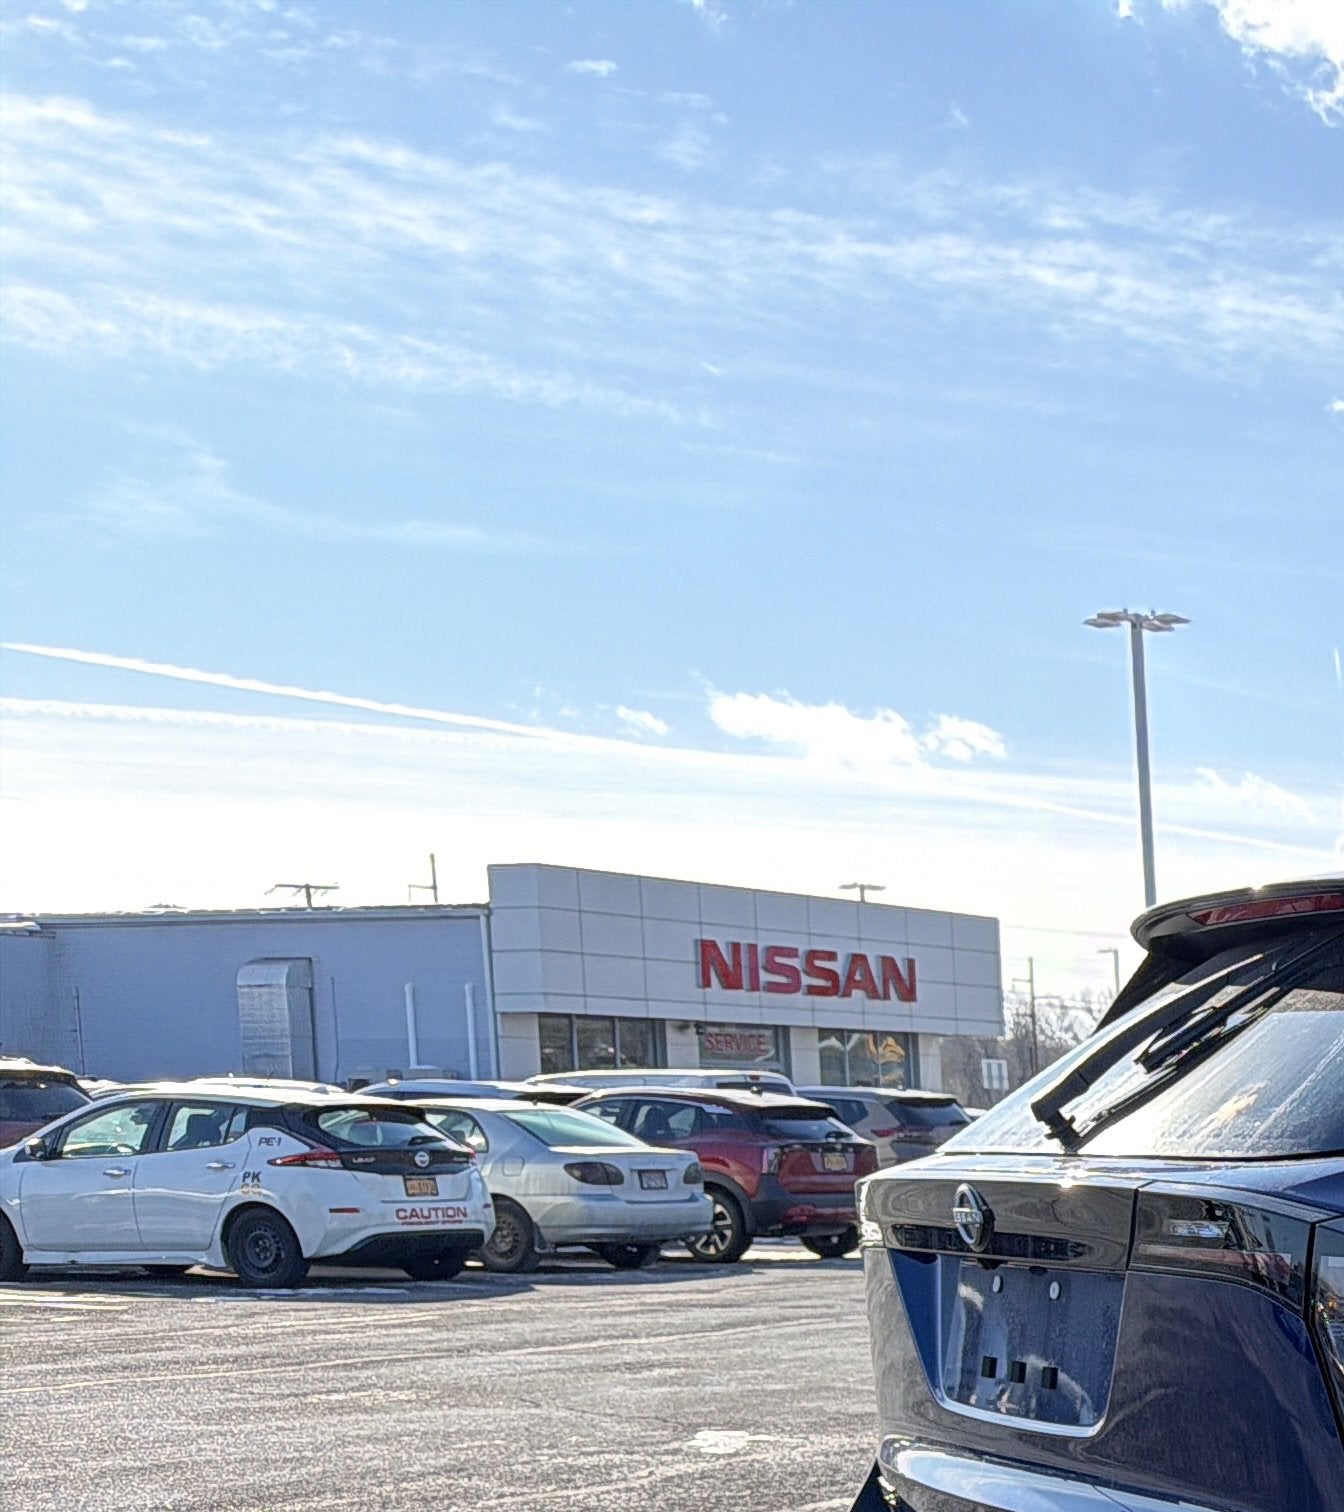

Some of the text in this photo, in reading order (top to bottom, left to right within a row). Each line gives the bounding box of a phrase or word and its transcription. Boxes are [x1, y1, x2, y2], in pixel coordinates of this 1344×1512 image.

[696, 938, 918, 1003] NISSAN
[704, 1031, 768, 1054] SERVICE
[395, 1206, 468, 1221] CAUTION
